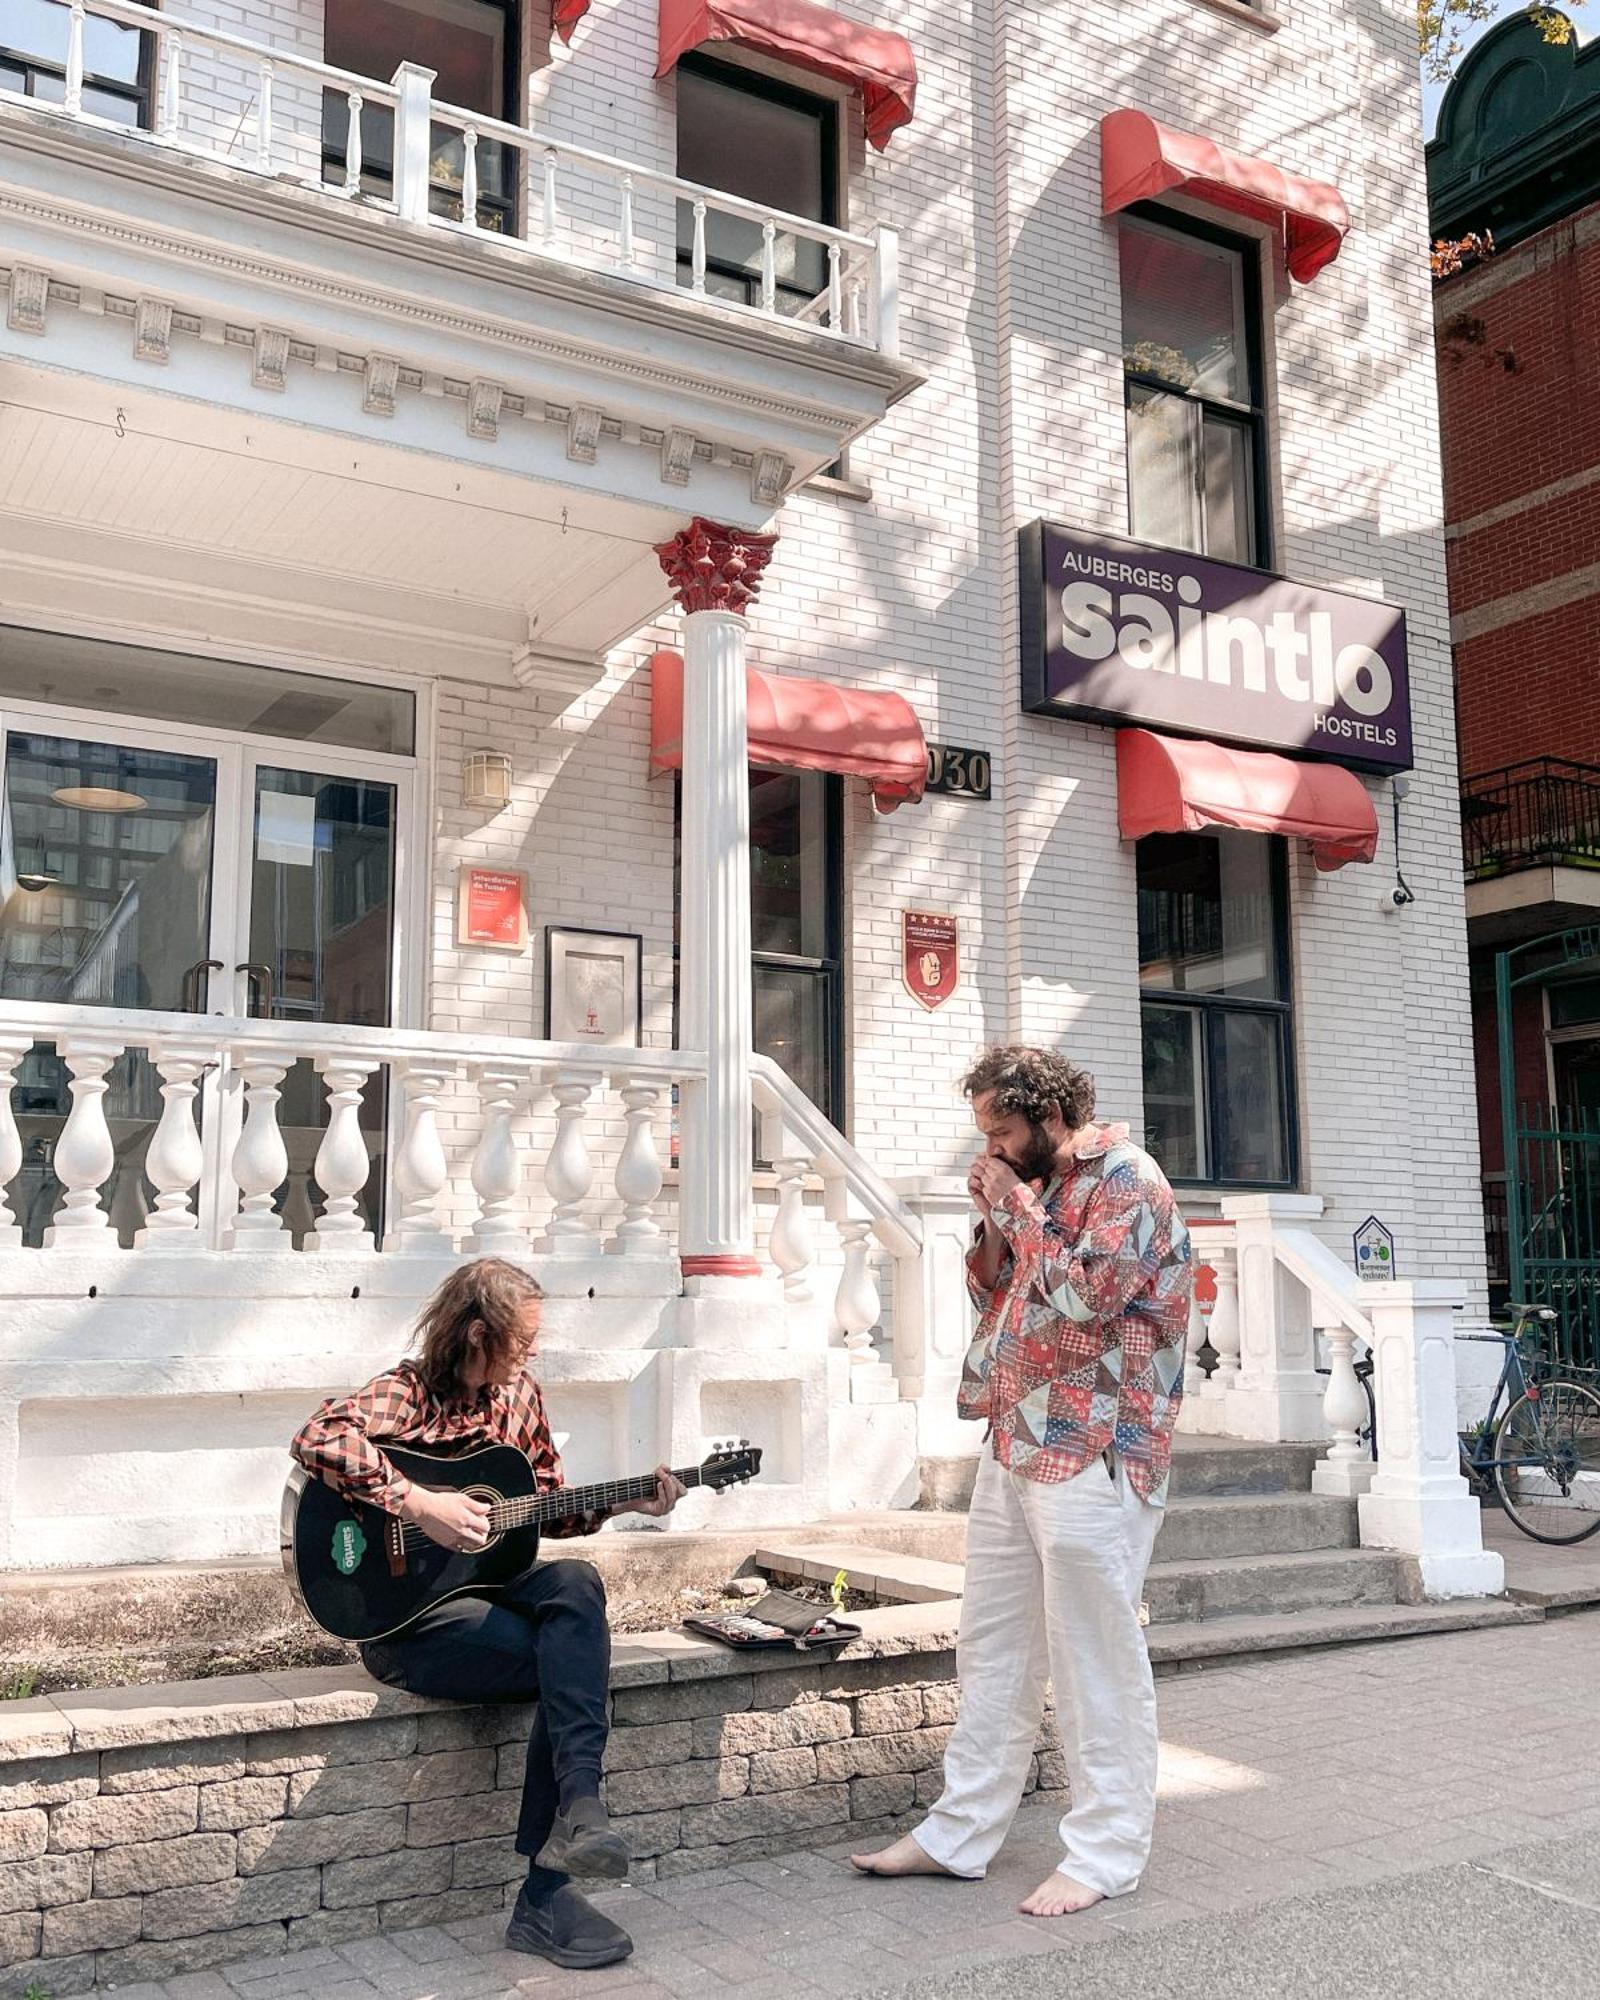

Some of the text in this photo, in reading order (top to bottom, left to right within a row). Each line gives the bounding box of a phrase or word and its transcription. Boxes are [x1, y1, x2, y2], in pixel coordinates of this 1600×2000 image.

[1062, 551, 1174, 593] AUBERGES
[1061, 575, 1393, 716] saintlo
[1313, 713, 1397, 746] HOSTELS
[343, 1526, 356, 1569] saintlo
